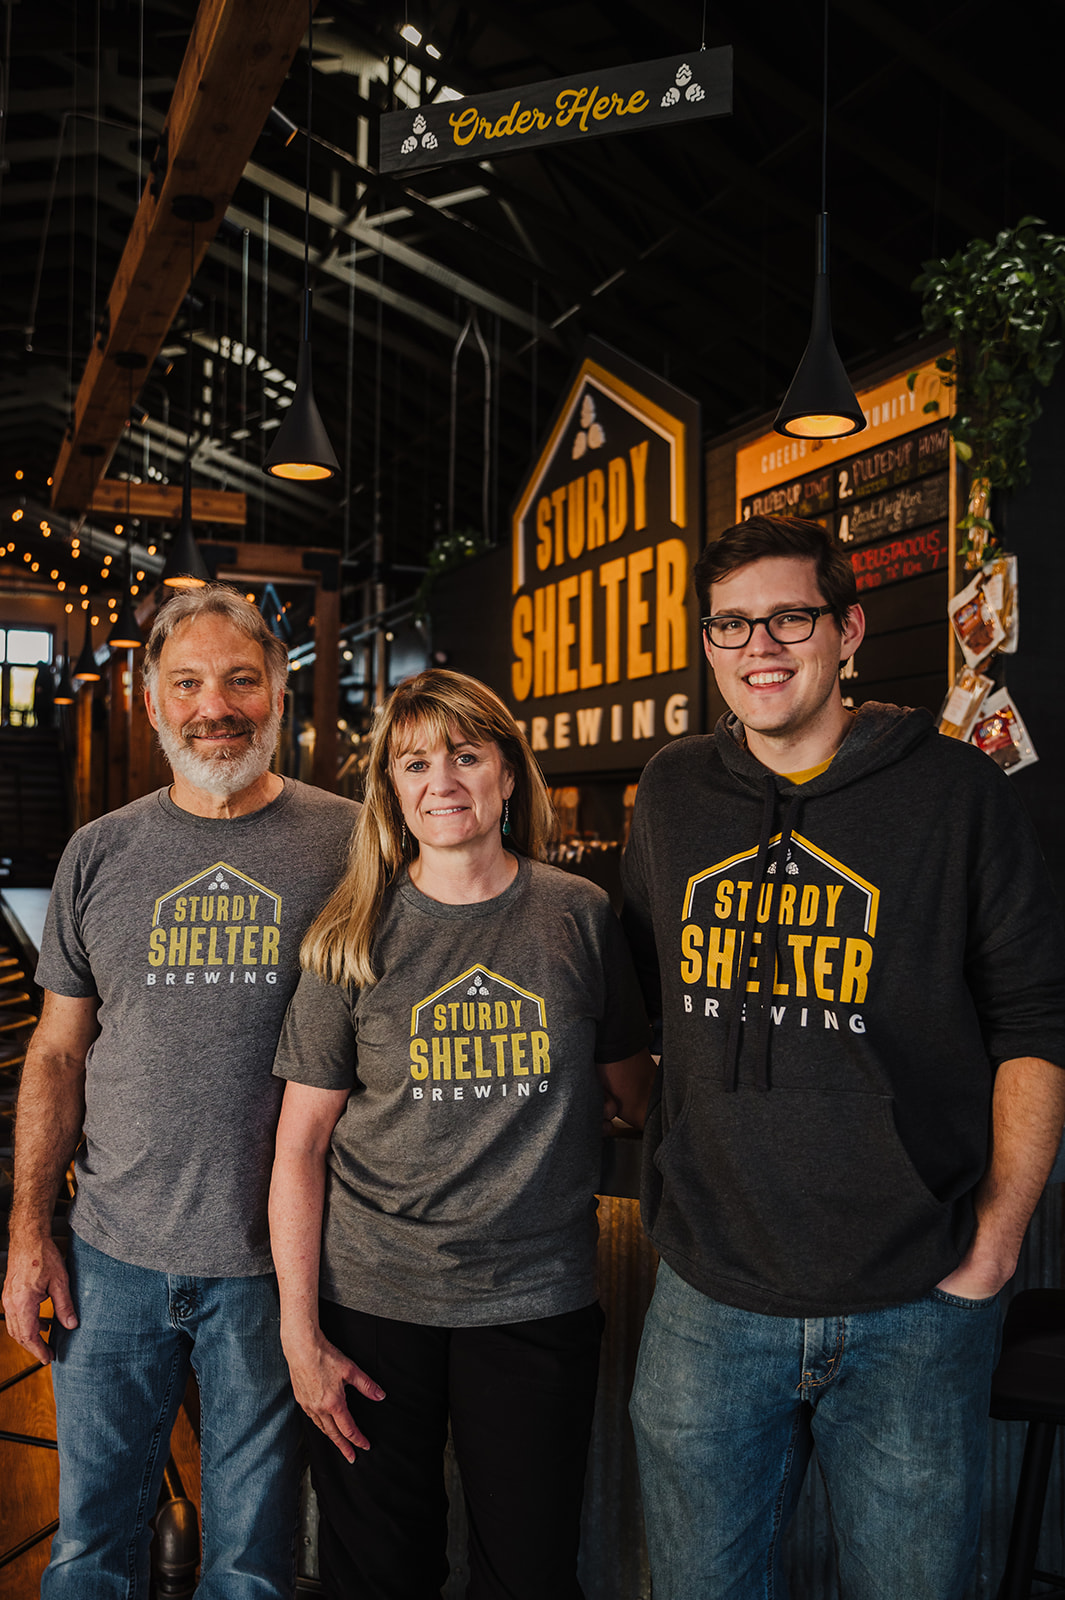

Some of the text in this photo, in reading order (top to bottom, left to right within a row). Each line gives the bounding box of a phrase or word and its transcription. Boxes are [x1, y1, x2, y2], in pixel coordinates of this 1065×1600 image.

[449, 86, 650, 146] Order Here
[839, 470, 853, 499] 2.
[536, 440, 649, 571] STURDY
[839, 514, 854, 543] 4.
[511, 537, 689, 701] SHELTER
[174, 895, 260, 922] STURDY
[713, 879, 844, 927] STURDY
[148, 926, 281, 967] SHELTER
[146, 971, 278, 985] BREWING
[433, 1000, 522, 1031] STURDY
[409, 1030, 551, 1081] SHELTER
[412, 1080, 549, 1101] BREWING
